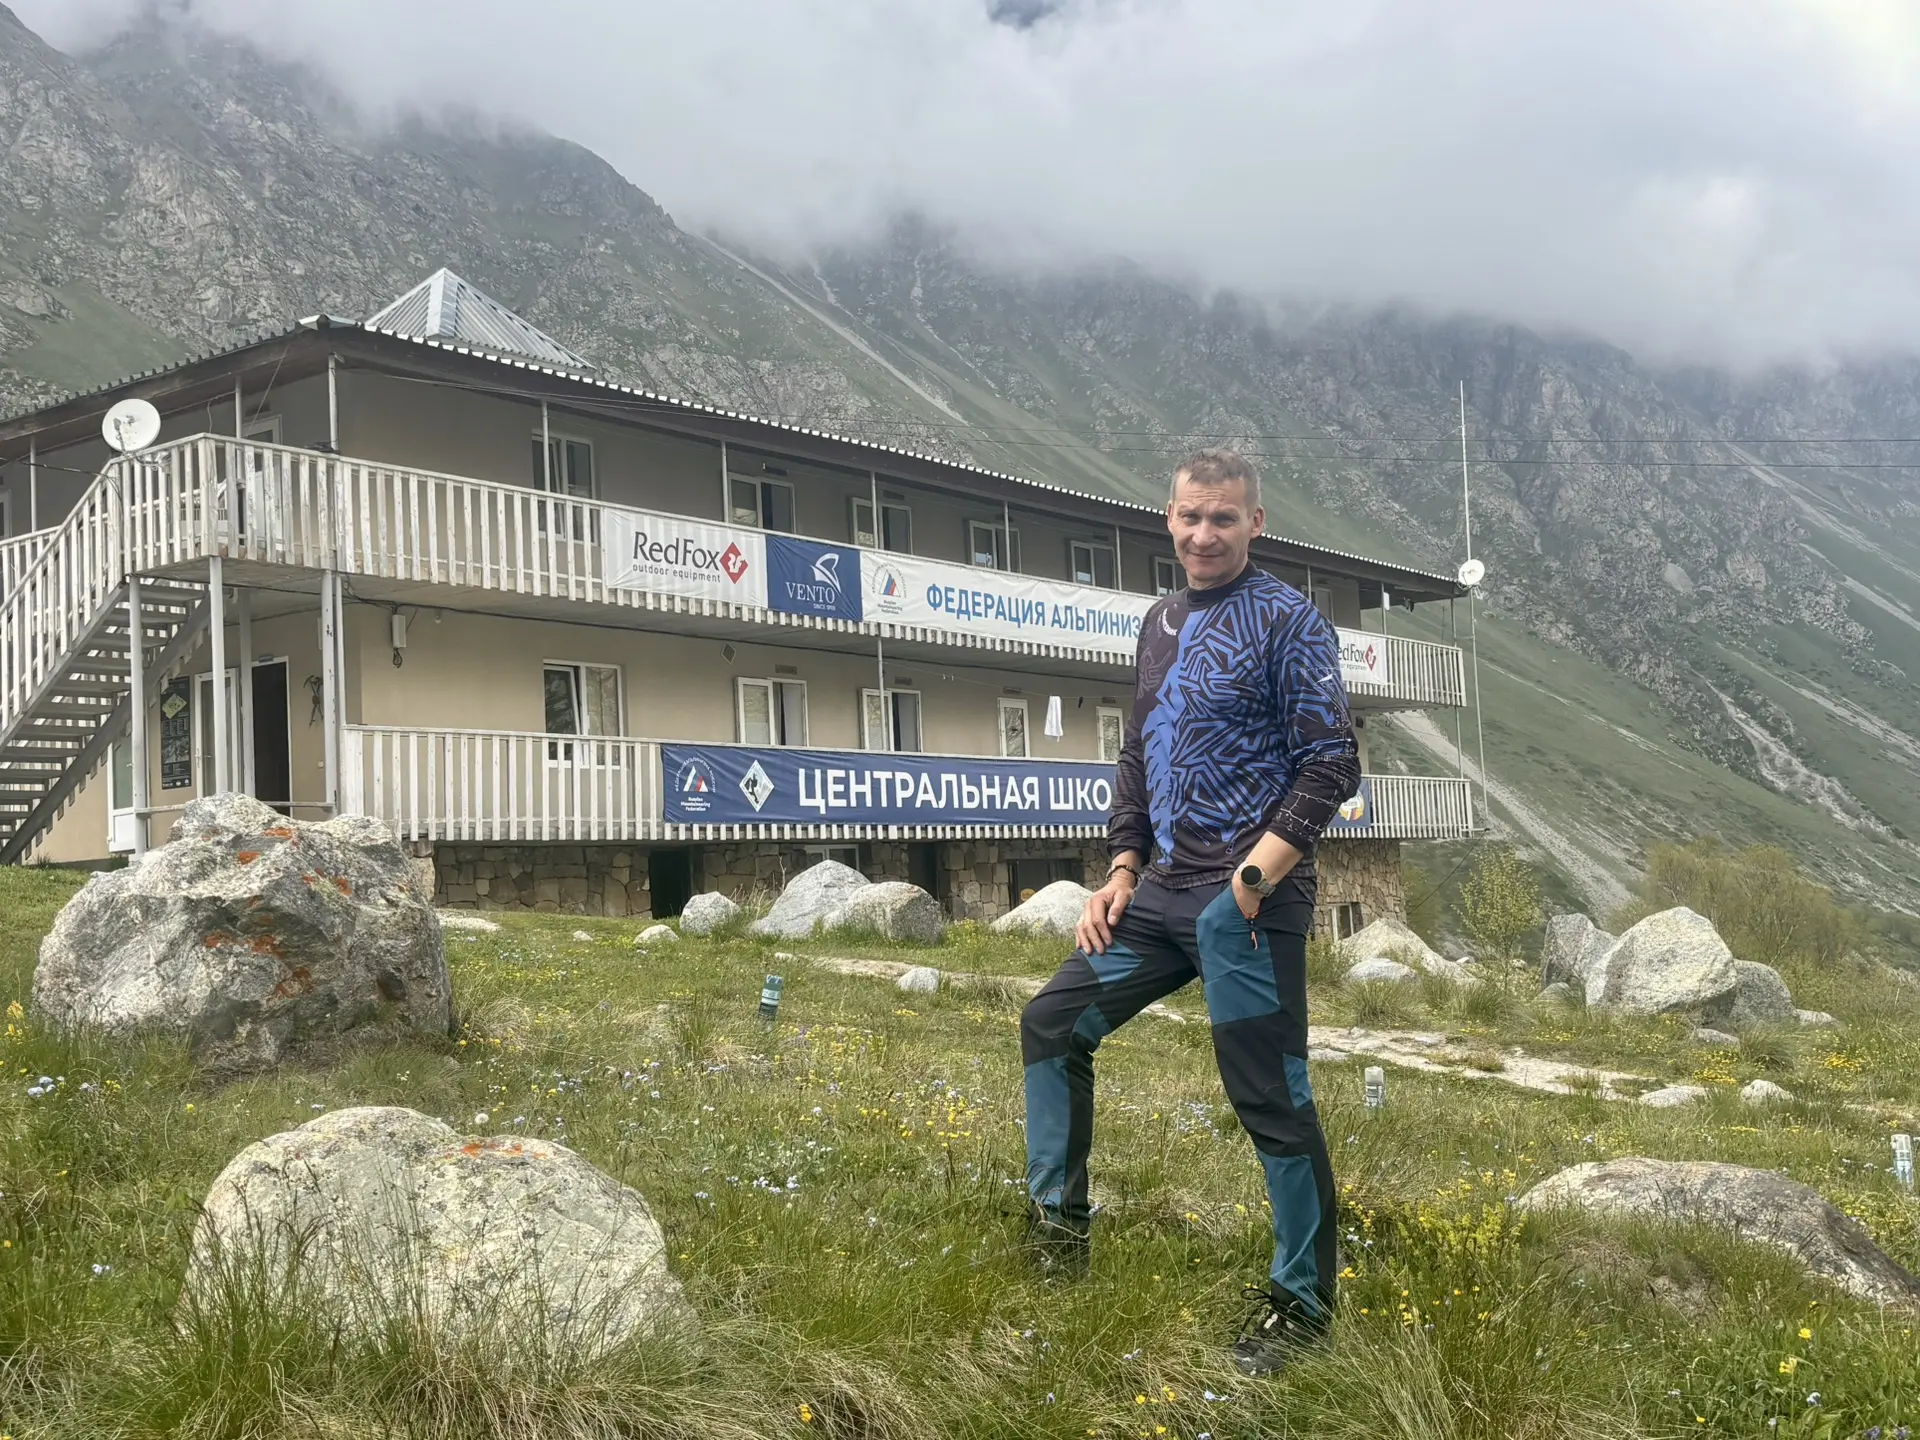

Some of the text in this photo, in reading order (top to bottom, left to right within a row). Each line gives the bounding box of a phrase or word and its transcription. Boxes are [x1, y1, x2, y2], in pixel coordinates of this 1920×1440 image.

[633, 531, 720, 571] RedFox
[632, 563, 721, 583] outdoor equipment
[785, 580, 835, 604] VENTO
[926, 583, 1046, 629] ФЕДЕРАЦИЯ
[798, 767, 1040, 814] ЦЕНТРАЛЬНАЯ
[1050, 776, 1112, 812] ШКО
